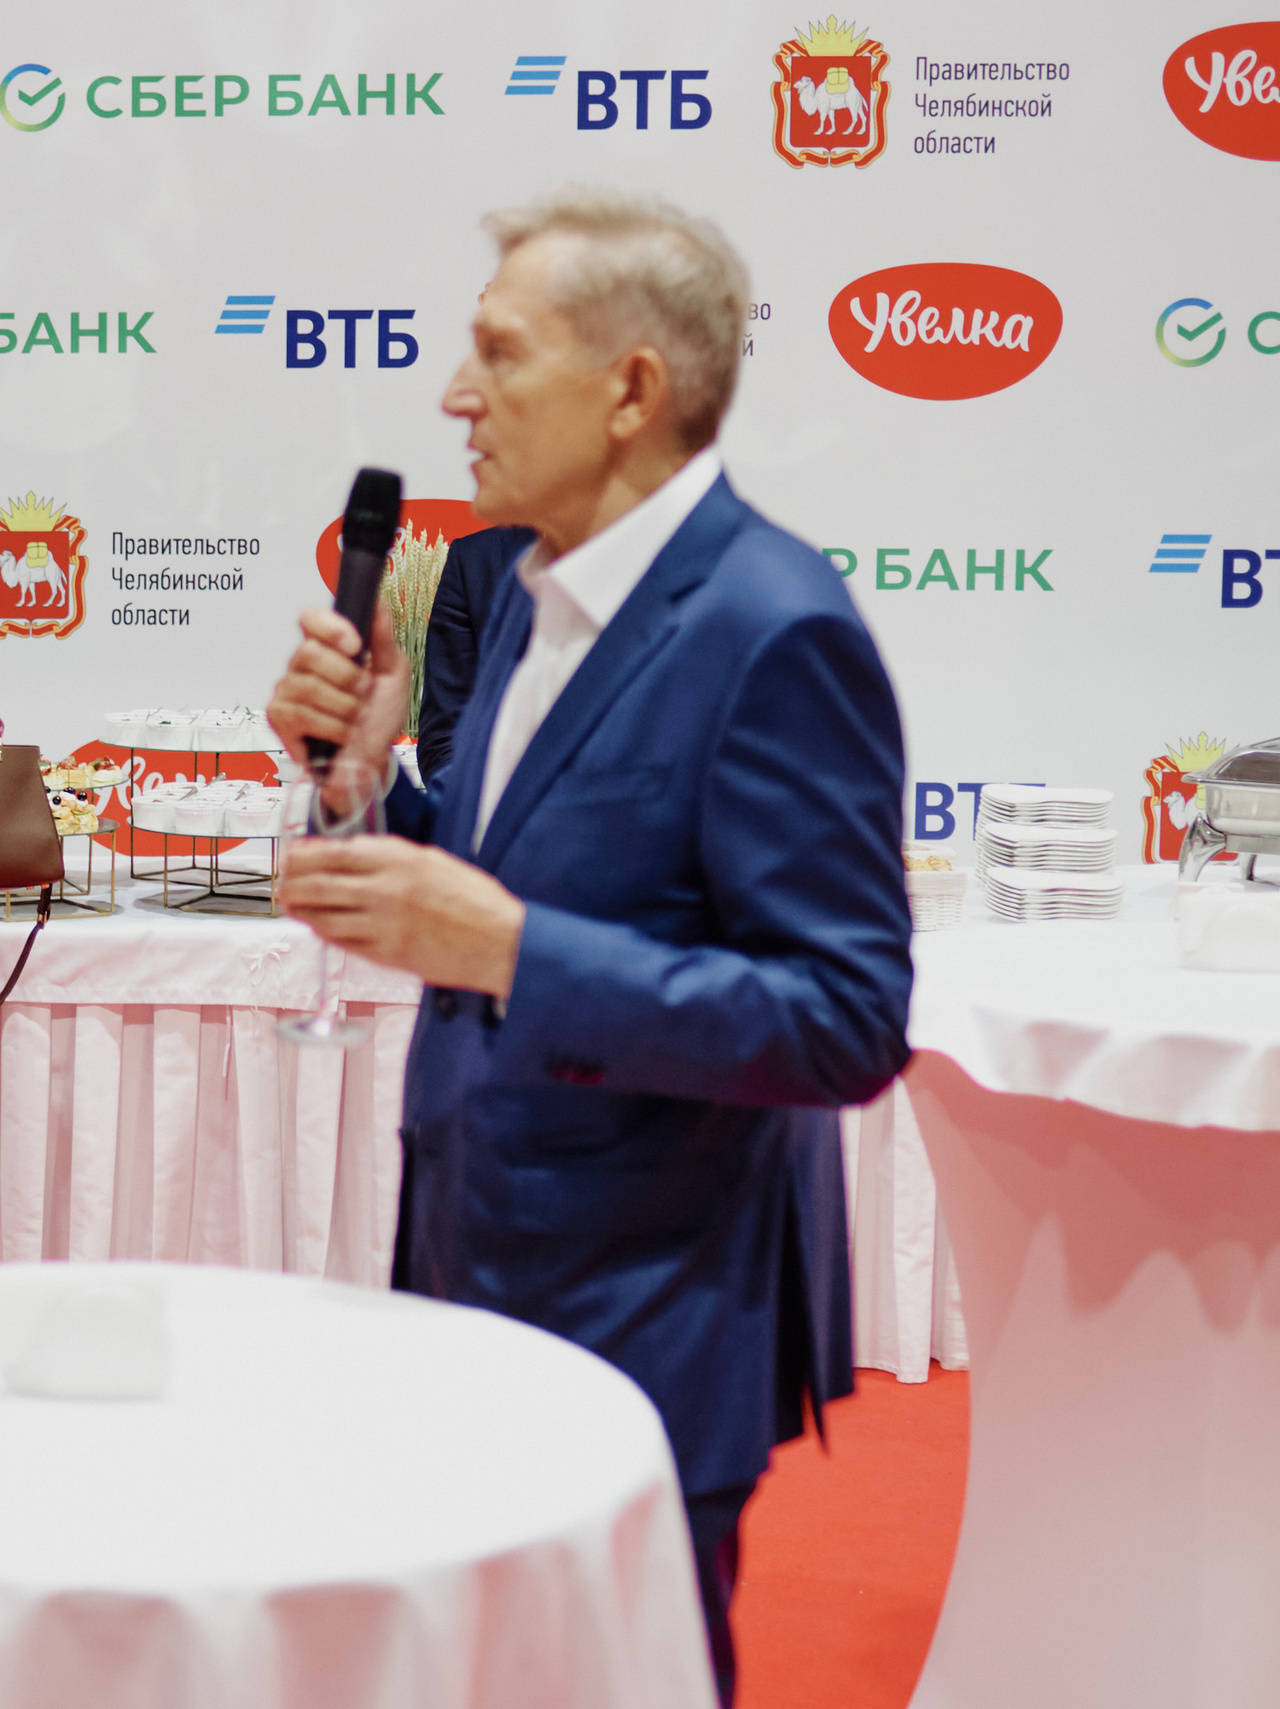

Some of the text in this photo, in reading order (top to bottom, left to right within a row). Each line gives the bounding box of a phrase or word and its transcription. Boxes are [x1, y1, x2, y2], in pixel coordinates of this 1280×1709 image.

[915, 56, 1070, 85] Правительство
[1184, 49, 1280, 114] Уве
[86, 73, 444, 119] СБЕР БАНК
[577, 69, 712, 131] ВТБ
[914, 92, 1052, 118] Челябинской
[913, 129, 996, 154] области
[286, 309, 419, 369] ВТБ
[849, 290, 1035, 353] Увелка
[112, 531, 260, 560] Правительство
[111, 566, 244, 591] Челябинской
[875, 548, 1053, 592] БАНК
[111, 601, 190, 626] области
